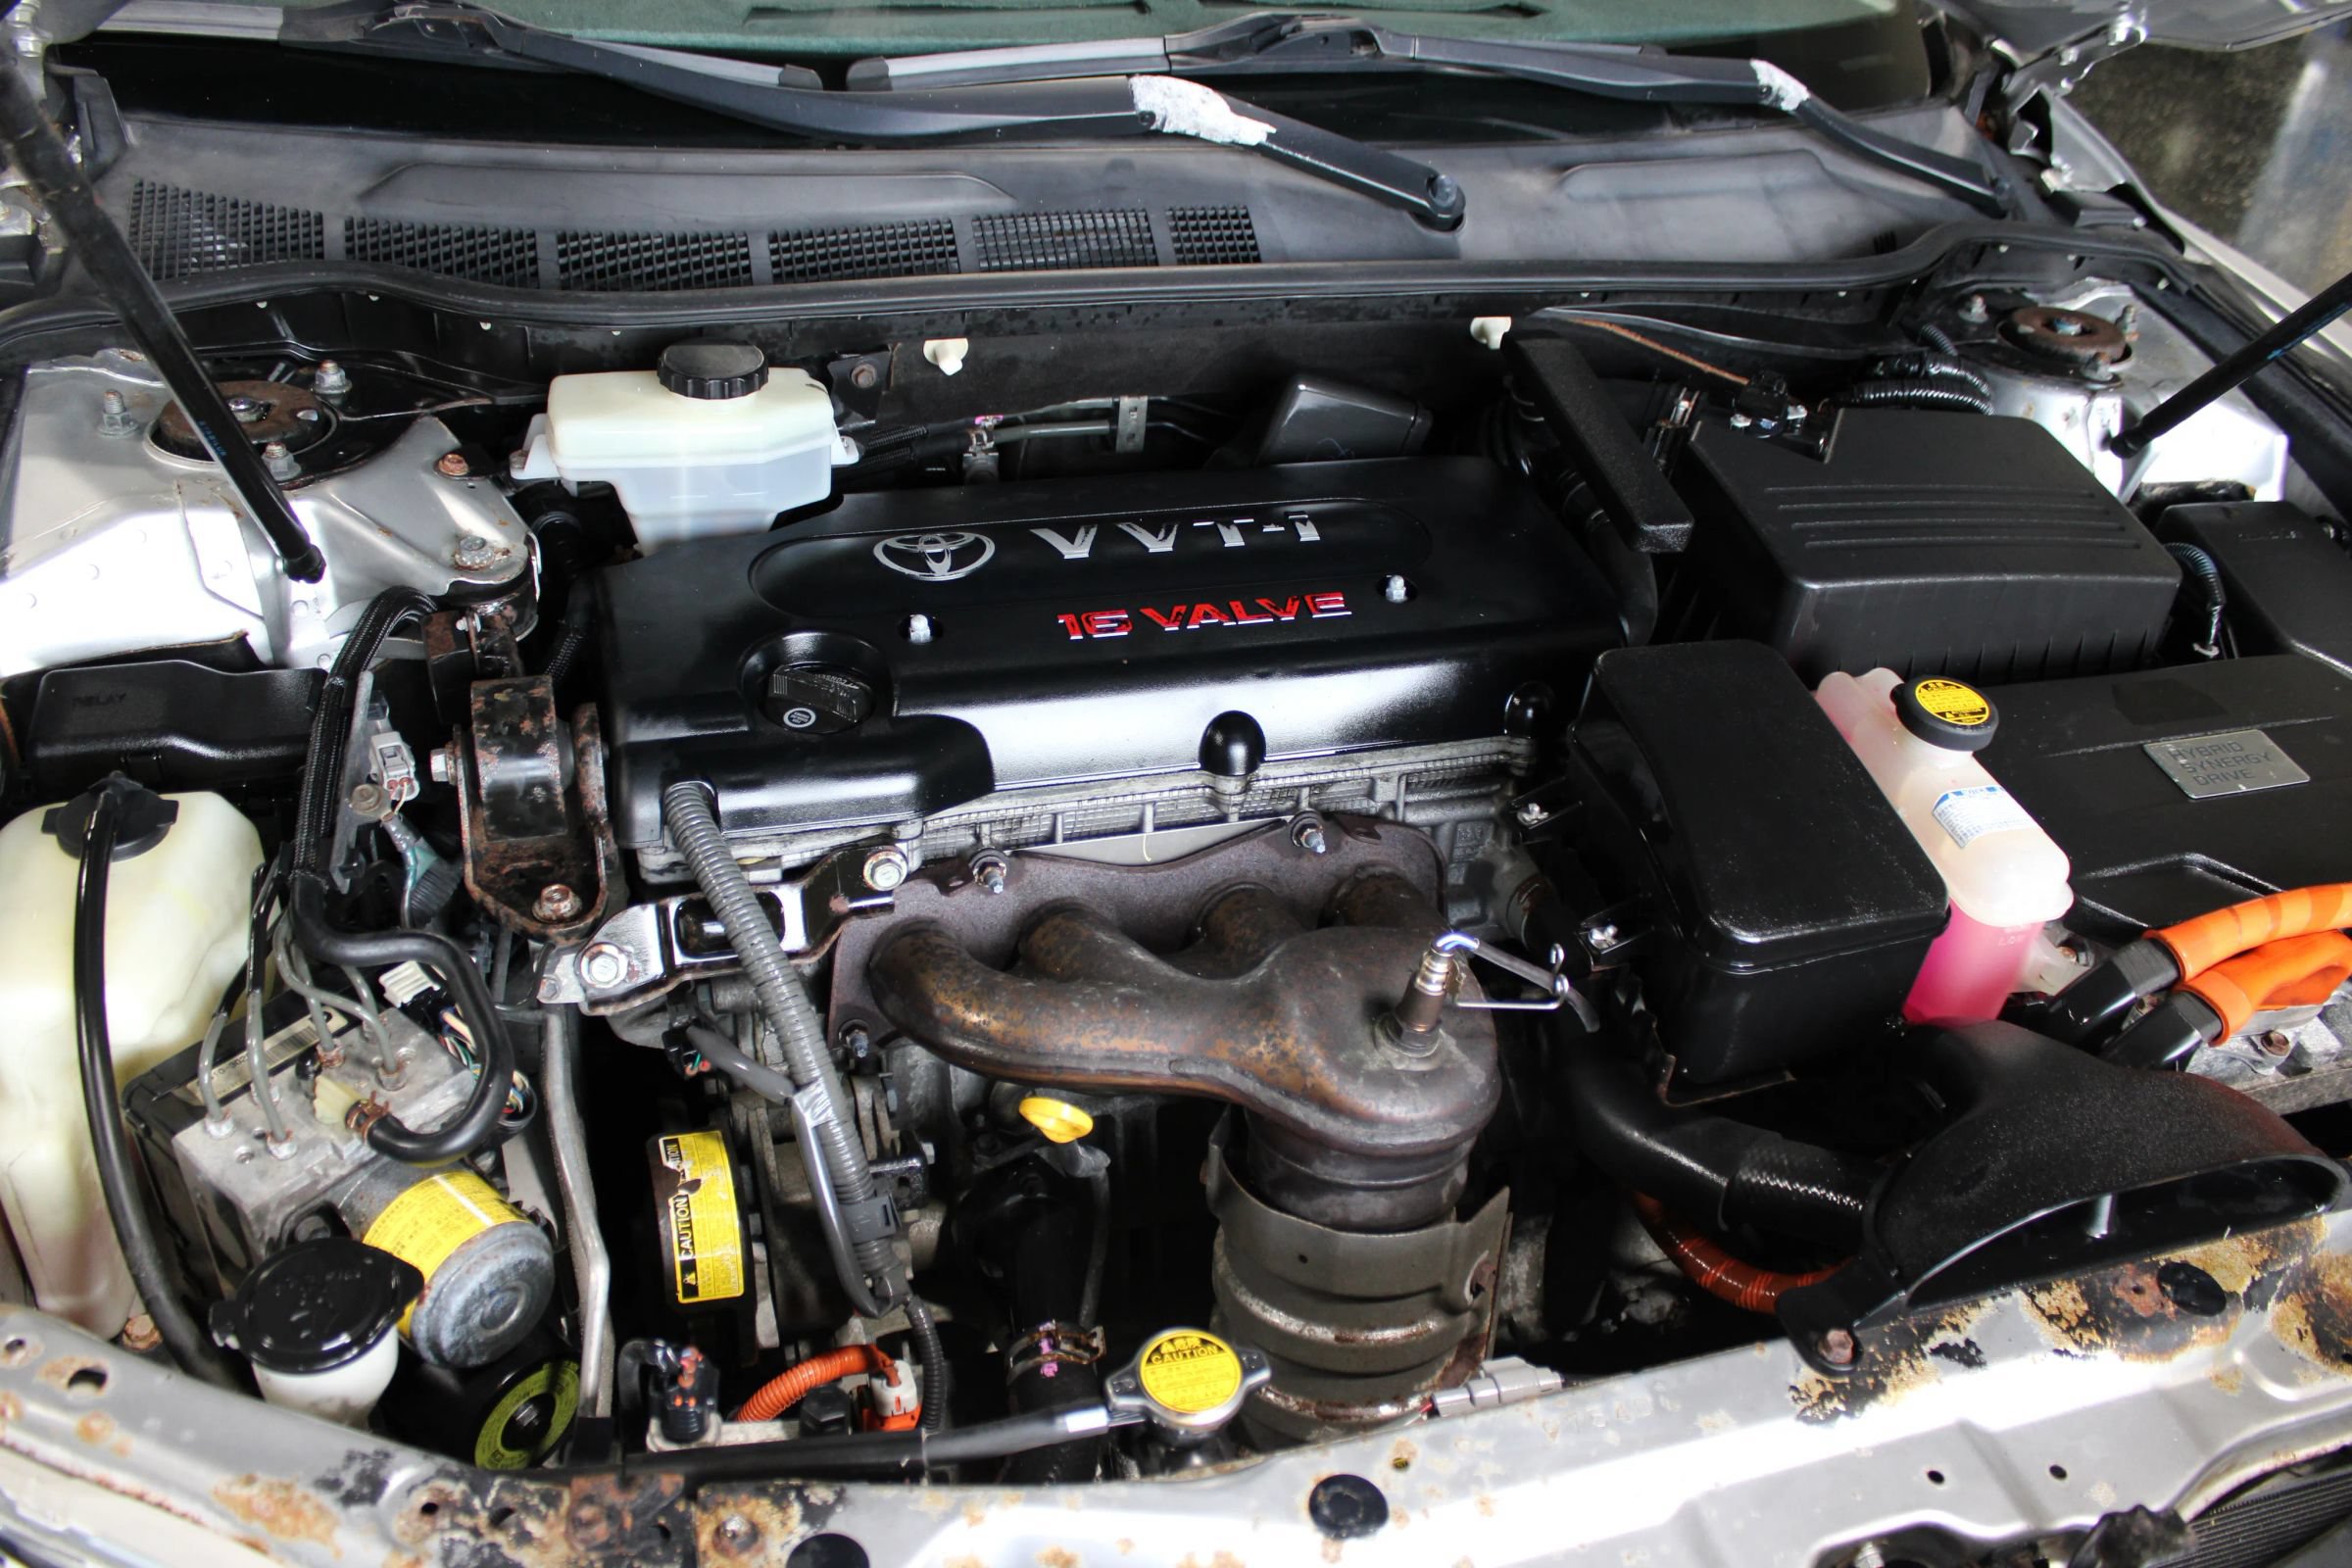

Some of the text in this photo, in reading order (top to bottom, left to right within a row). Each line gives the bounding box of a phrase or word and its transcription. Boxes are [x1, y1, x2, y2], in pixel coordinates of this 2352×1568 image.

[1056, 591, 1352, 641] 16 VALVE
[2169, 741, 2243, 760] HYBRID
[2180, 752, 2274, 774] SYNERGY
[2192, 769, 2257, 786] DRIVE
[675, 1198, 695, 1259] CAUTION
[1152, 1346, 1217, 1364] CAUTION
